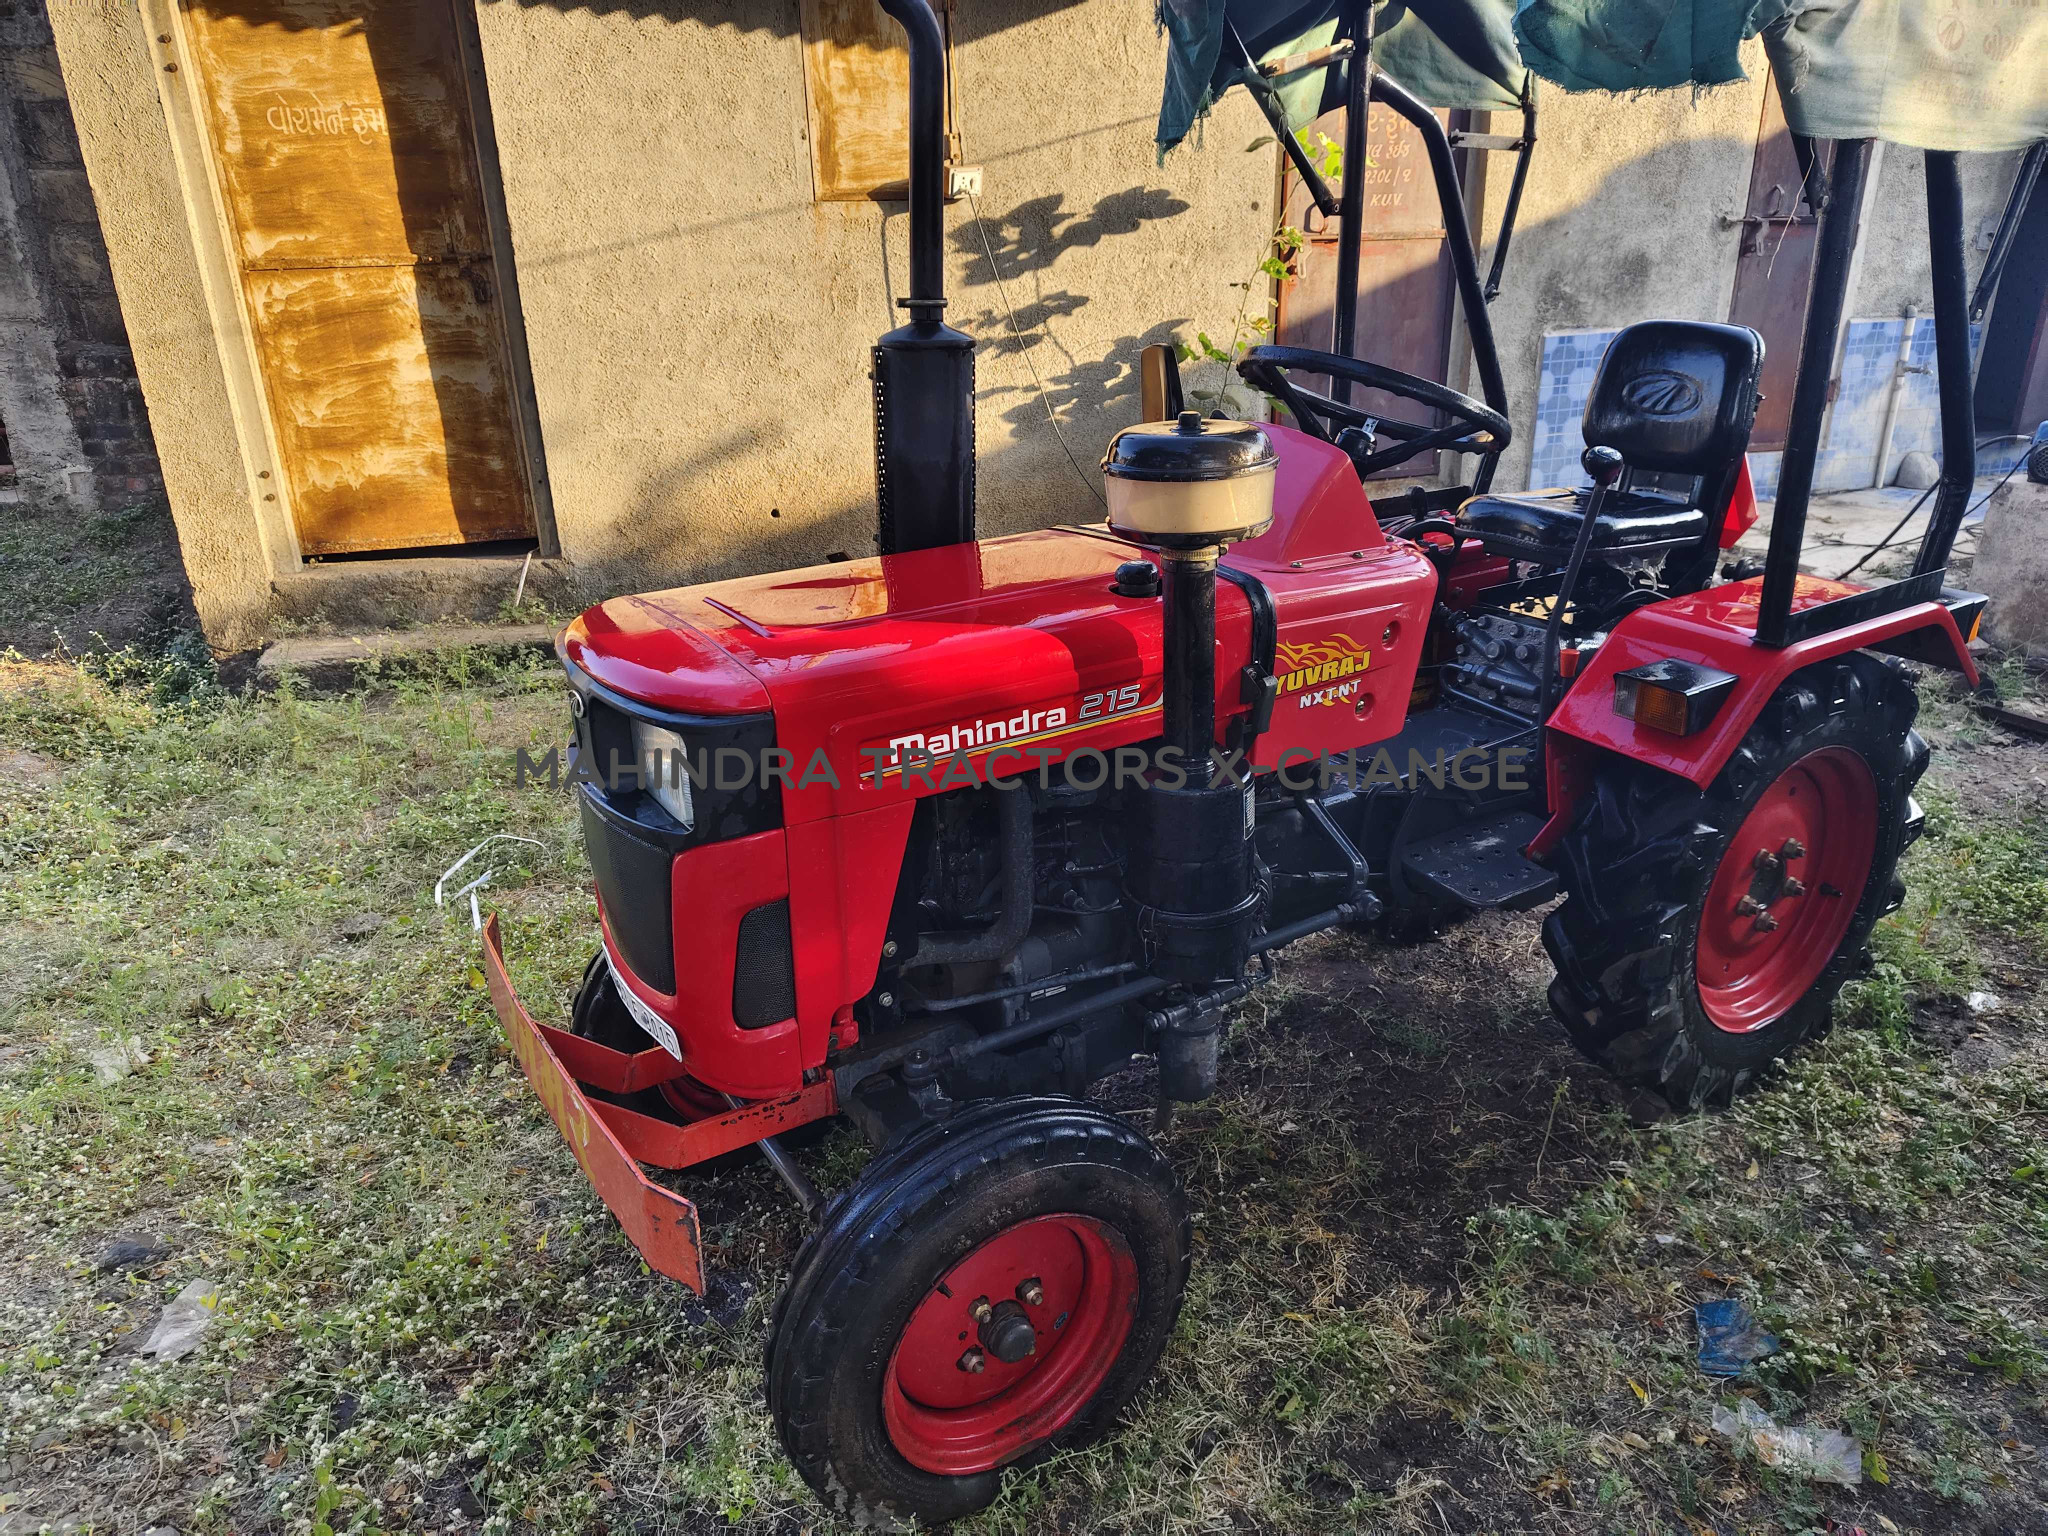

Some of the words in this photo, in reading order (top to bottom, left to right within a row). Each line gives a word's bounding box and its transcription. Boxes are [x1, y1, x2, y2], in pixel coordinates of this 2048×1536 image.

[1369, 193, 1403, 207] K.U.V.
[1276, 650, 1371, 696] YUVRAJ
[1078, 683, 1142, 720] 215
